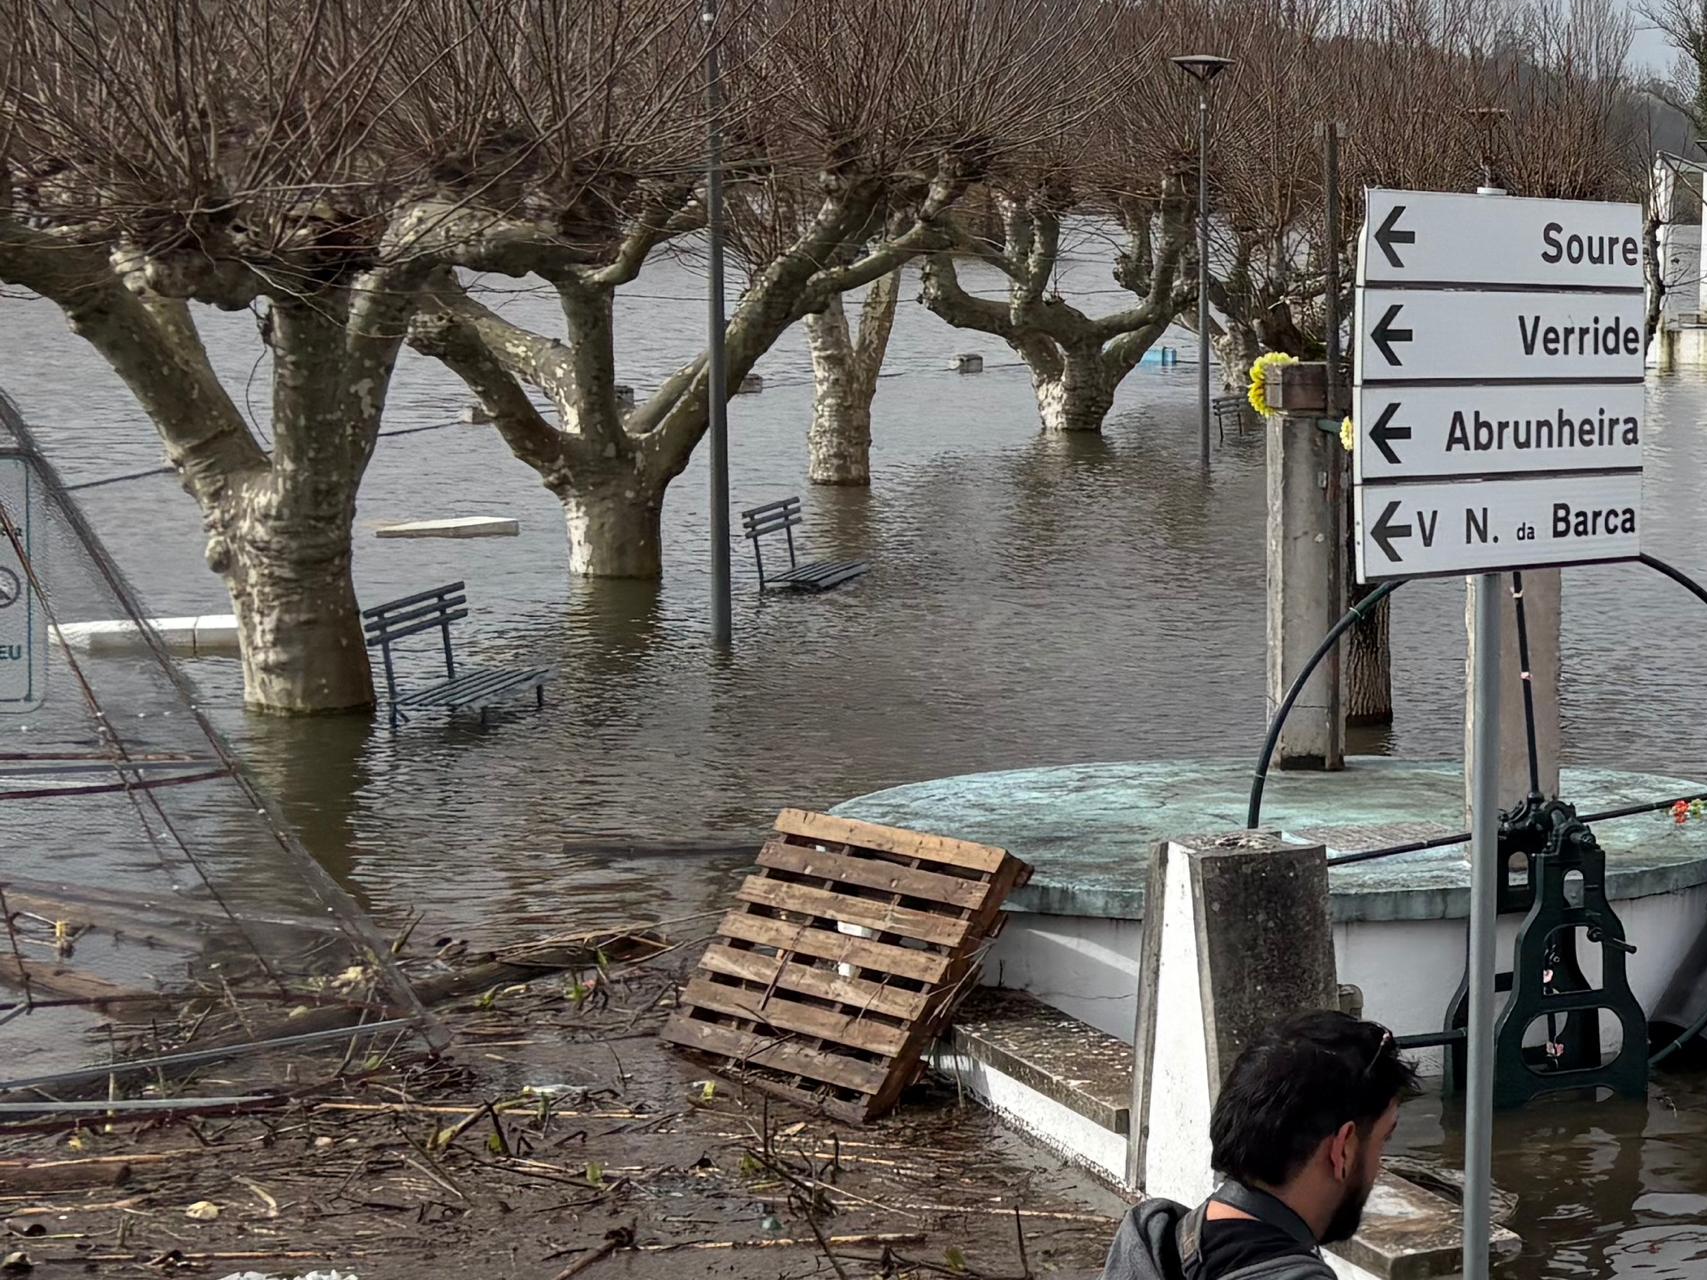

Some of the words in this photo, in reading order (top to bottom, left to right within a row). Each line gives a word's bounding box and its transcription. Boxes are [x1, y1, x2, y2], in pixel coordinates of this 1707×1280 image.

[1541, 222, 1639, 266] Soure
[1518, 315, 1640, 356] Verride
[1445, 407, 1640, 452] Abrunheira
[1416, 510, 1438, 547] V
[1465, 507, 1499, 545] N.
[1516, 522, 1536, 541] da
[1552, 502, 1636, 539] Barca
